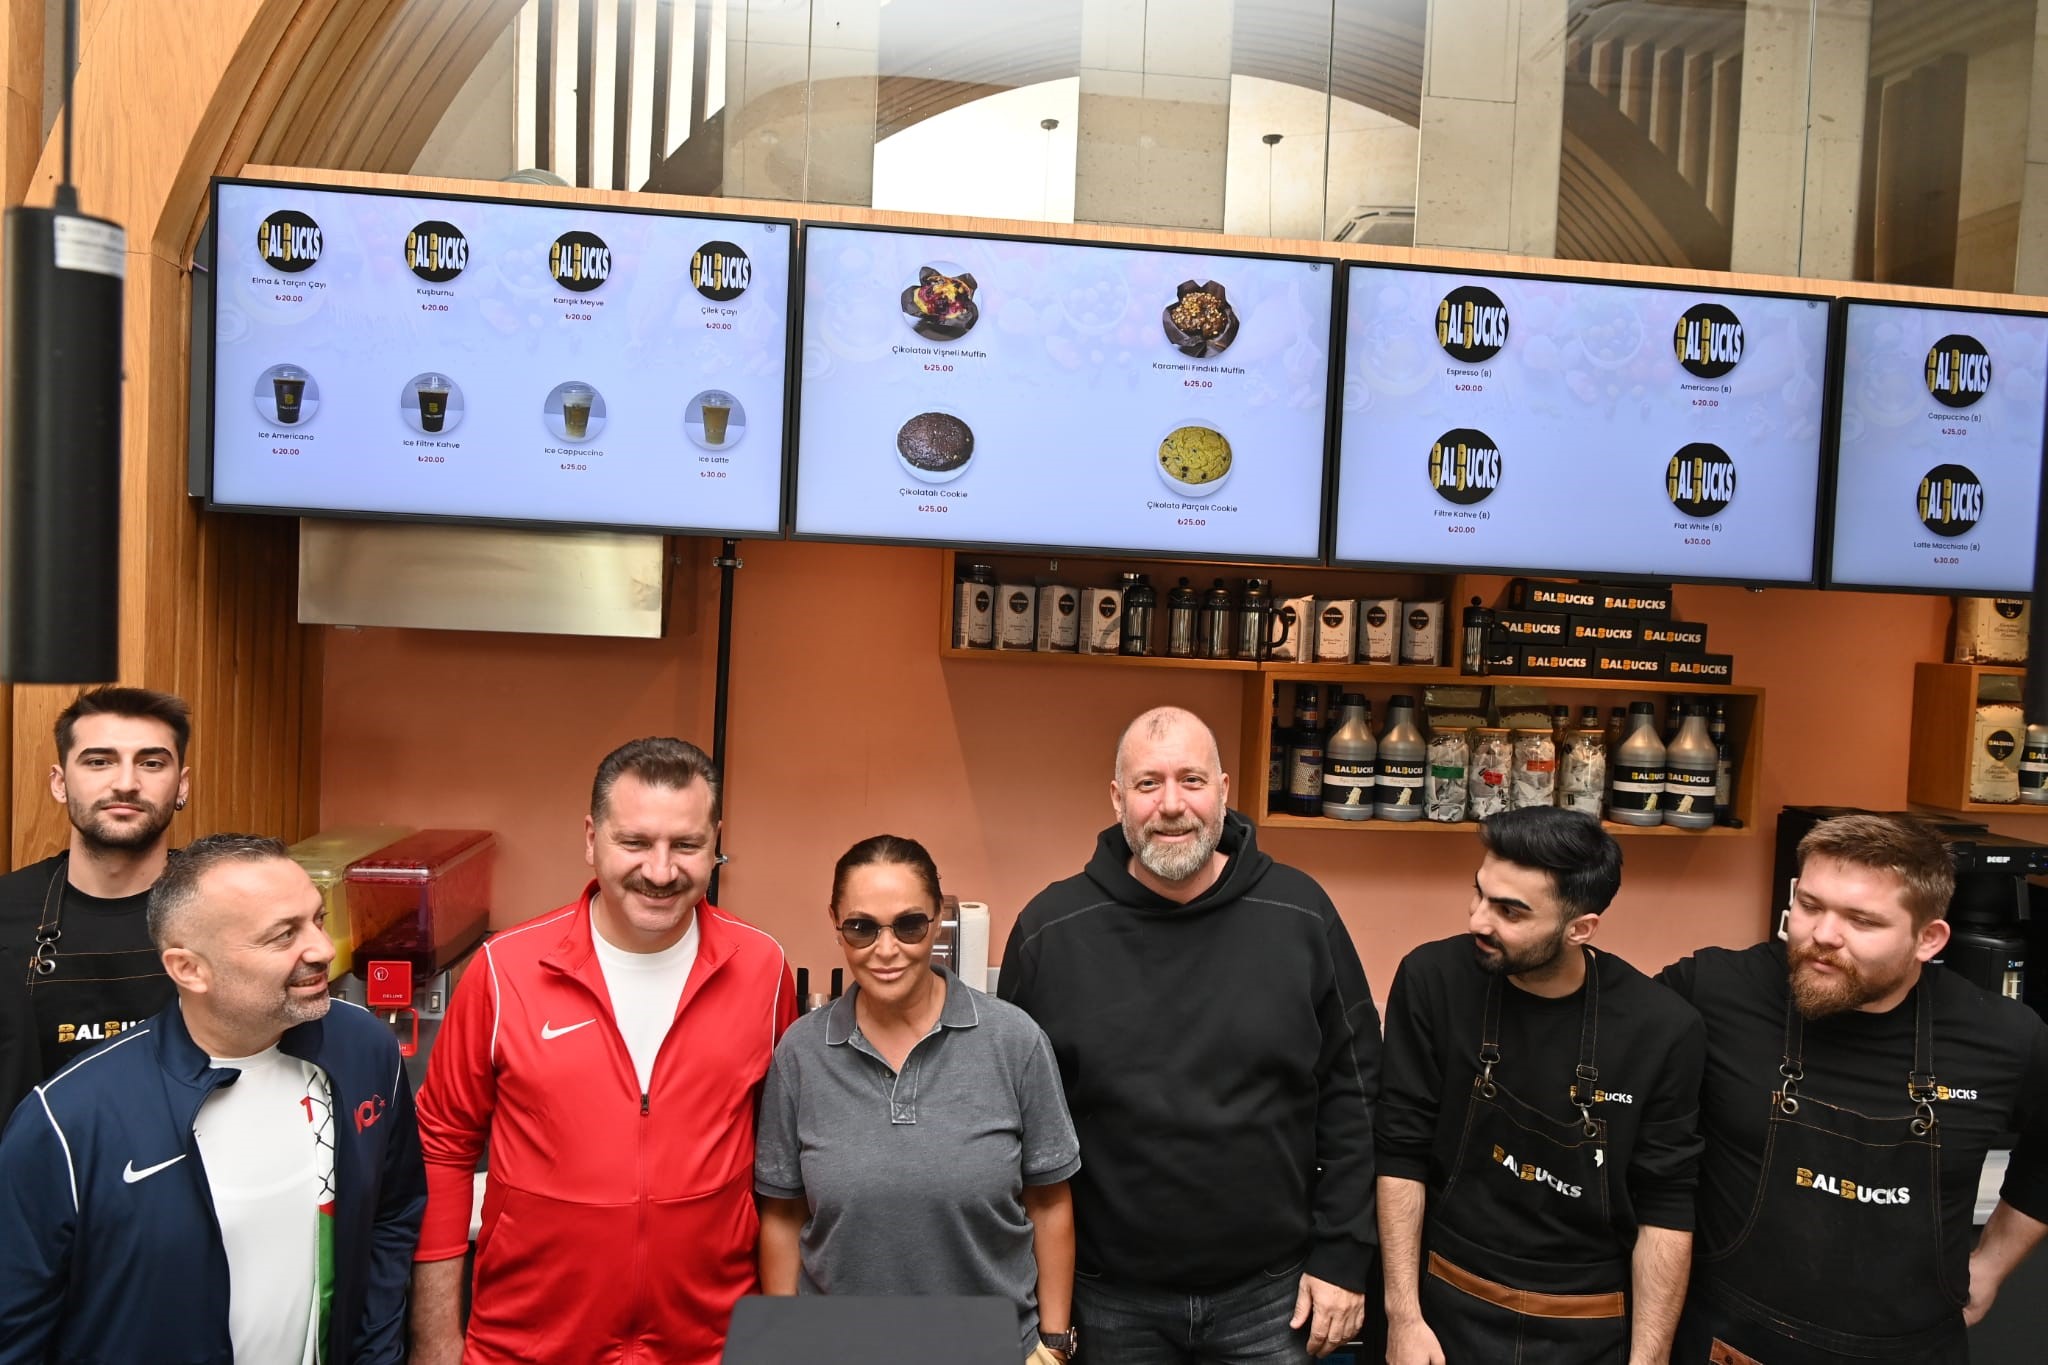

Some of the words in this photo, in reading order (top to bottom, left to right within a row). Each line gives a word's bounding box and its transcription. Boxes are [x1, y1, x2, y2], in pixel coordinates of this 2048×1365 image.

[252, 276, 272, 285] Elma
[416, 287, 455, 298] Kuşburnu
[580, 298, 605, 308] Meyve
[961, 350, 987, 359] Muffin
[1152, 362, 1190, 371] Karamelli
[1220, 366, 1245, 375] Muffin
[1446, 367, 1479, 377] Espresso
[1680, 383, 1719, 393] Americano
[1928, 412, 1969, 422] Cappuccino
[258, 431, 270, 439] Ice
[271, 432, 315, 441] Americano
[403, 439, 415, 447] Ice
[416, 440, 435, 449] Filtre
[436, 440, 461, 449] Kahve
[544, 447, 556, 455] Ice
[557, 447, 604, 458] Cappuccino
[711, 456, 730, 464] Latte
[940, 488, 968, 498] Cookie
[1210, 504, 1238, 513] Cookie
[1434, 509, 1452, 518] Filtre
[1454, 510, 1477, 519] Kahve
[1673, 521, 1690, 530] Flat
[1690, 522, 1710, 531] White
[1913, 541, 1931, 549] Latte
[1932, 542, 1969, 551] Macchiato
[1534, 590, 1594, 605] BALBUCKS
[1605, 597, 1666, 609] BALBUCKS
[1575, 626, 1633, 639] BALBUCKS
[1644, 629, 1702, 643] BALBUCKS
[1527, 656, 1587, 668] BALBUCKS
[1600, 658, 1658, 671] BALBUCKS
[1670, 662, 1728, 675] BALBUCKS
[1492, 1143, 1584, 1198] BALBUCKS
[1796, 1167, 1911, 1205] BALBUCKS
